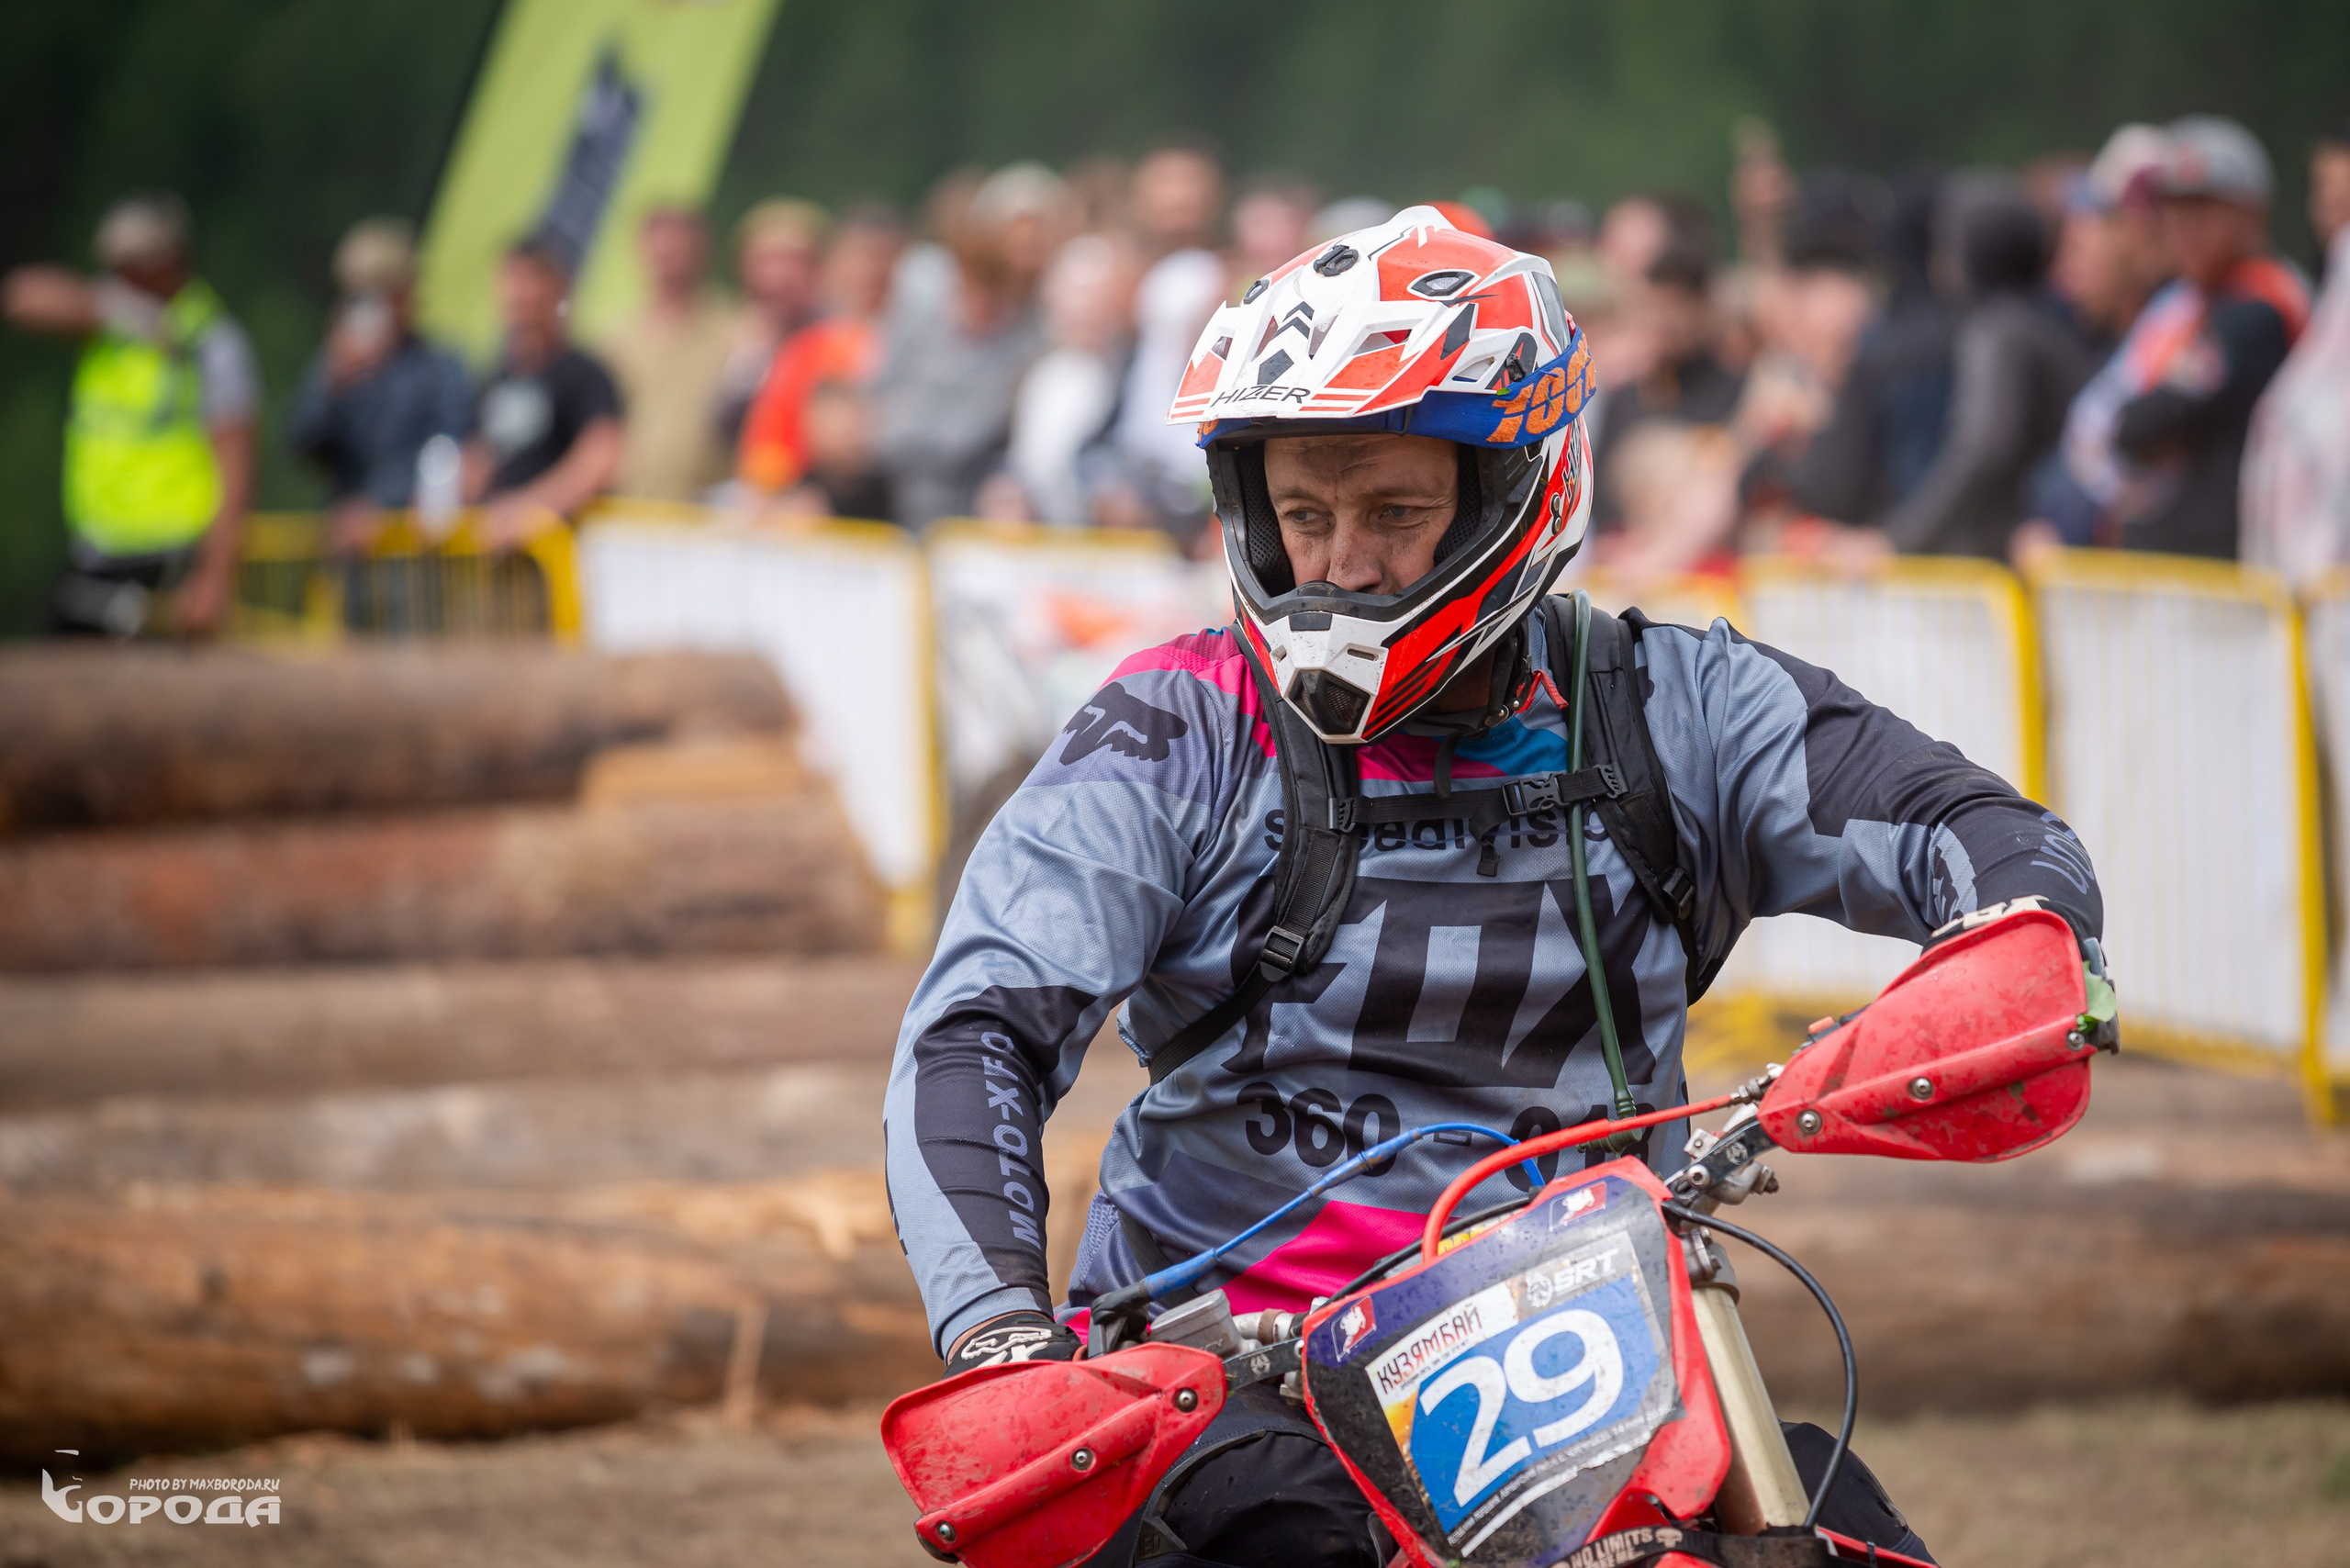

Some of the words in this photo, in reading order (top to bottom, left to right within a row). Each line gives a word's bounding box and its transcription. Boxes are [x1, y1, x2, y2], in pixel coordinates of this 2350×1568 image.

[1210, 384, 1311, 408] HIZER
[1236, 1081, 1402, 1178] 360
[1377, 1303, 1483, 1394] КУЗЯМБАЙ
[1419, 1308, 1624, 1508] 29
[1595, 1526, 1653, 1558] LIMITS
